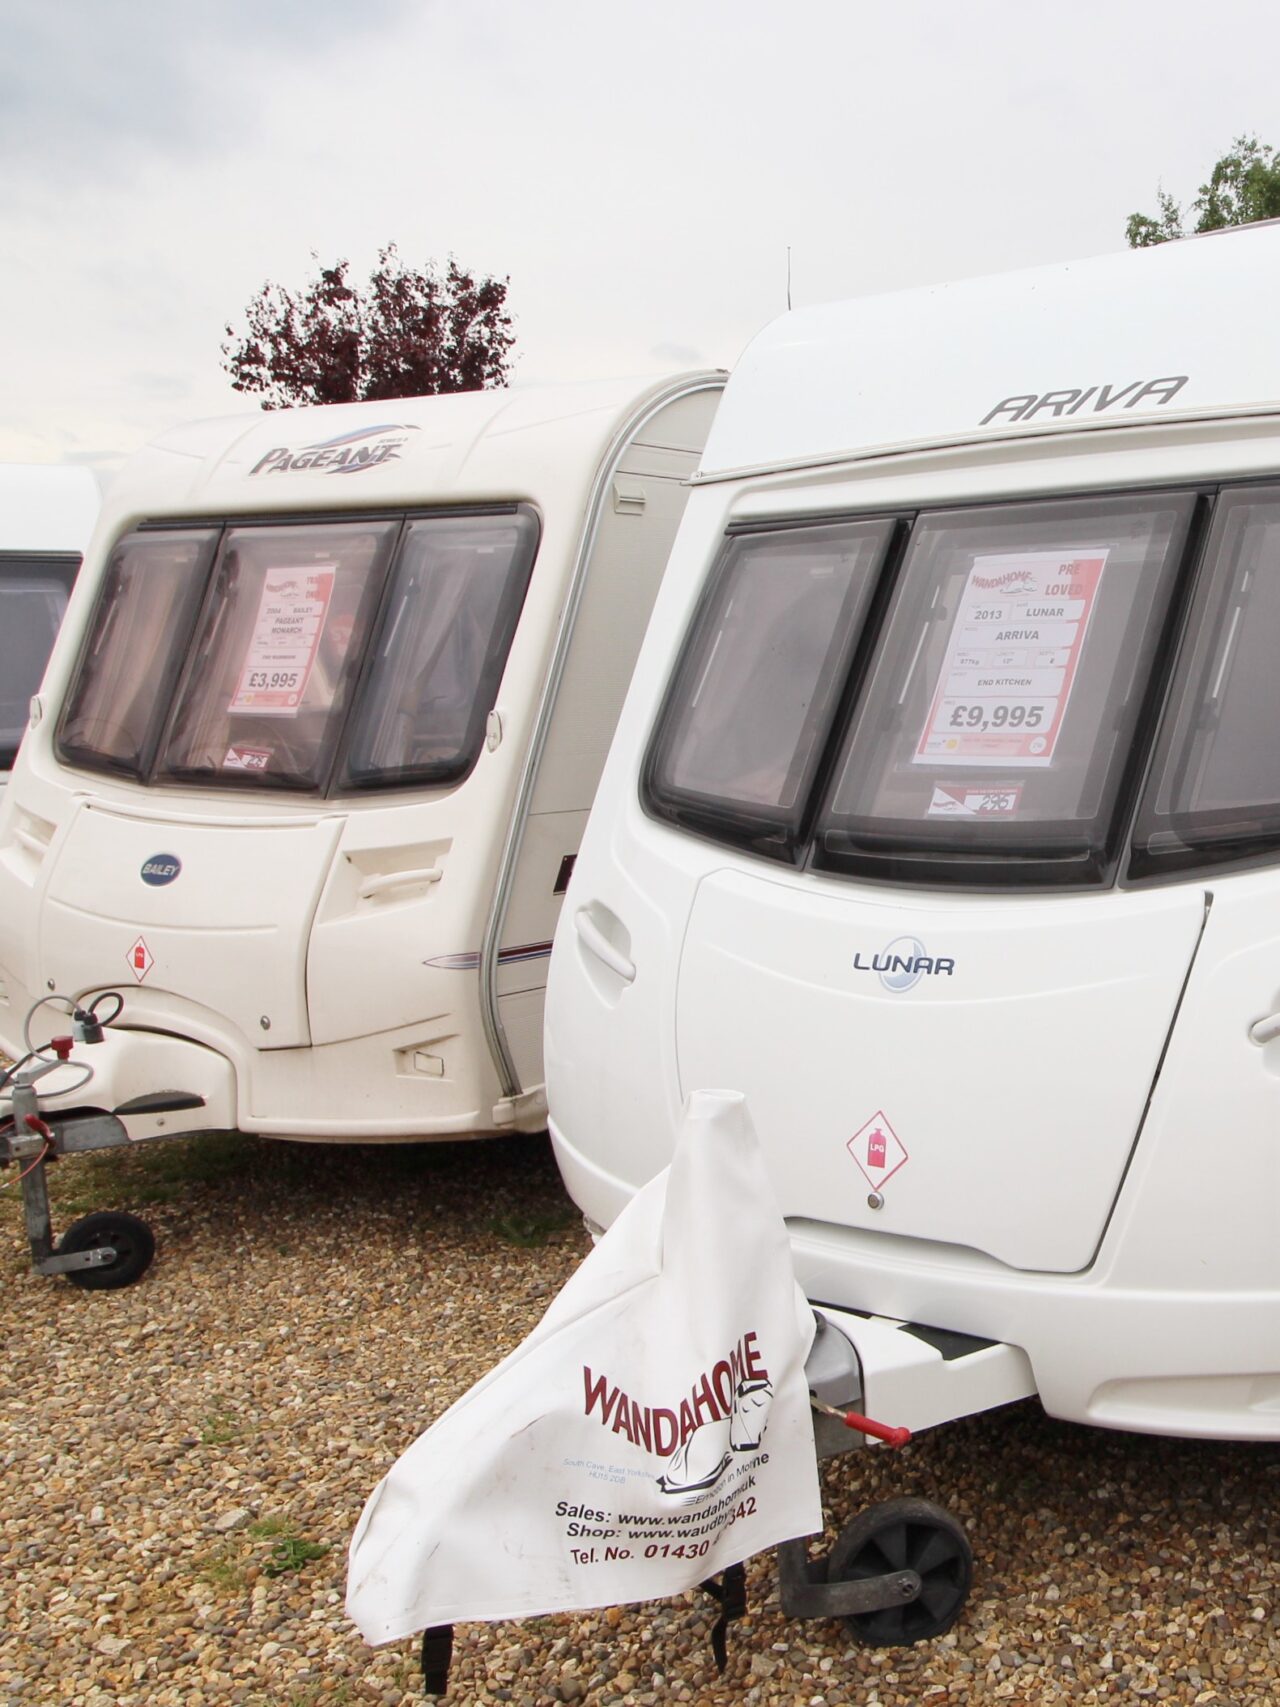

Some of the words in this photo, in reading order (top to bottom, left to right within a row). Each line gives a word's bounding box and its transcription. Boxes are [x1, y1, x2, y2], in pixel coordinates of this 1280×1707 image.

[978, 375, 1189, 426] ARIVA
[248, 443, 403, 477] PAGEANT
[1058, 563, 1081, 576] PRE
[1045, 583, 1083, 596] LOVED
[974, 609, 1003, 620] 2013
[1026, 607, 1065, 617] LUNAR
[995, 630, 1040, 642] ARRIVA
[248, 672, 299, 691] £3,995
[977, 679, 994, 687] END
[995, 678, 1033, 687] KITCHEN
[948, 705, 1045, 732] £9,995
[142, 863, 179, 876] BAILEY
[853, 952, 956, 976] LUNAR
[869, 1142, 885, 1153] LPG
[583, 1331, 769, 1458] WANDAHOME
[555, 1501, 612, 1523] Sales:
[566, 1522, 622, 1540] Shop:
[571, 1548, 599, 1565] Tel.
[604, 1546, 635, 1562] No.
[643, 1539, 710, 1560] 01430
